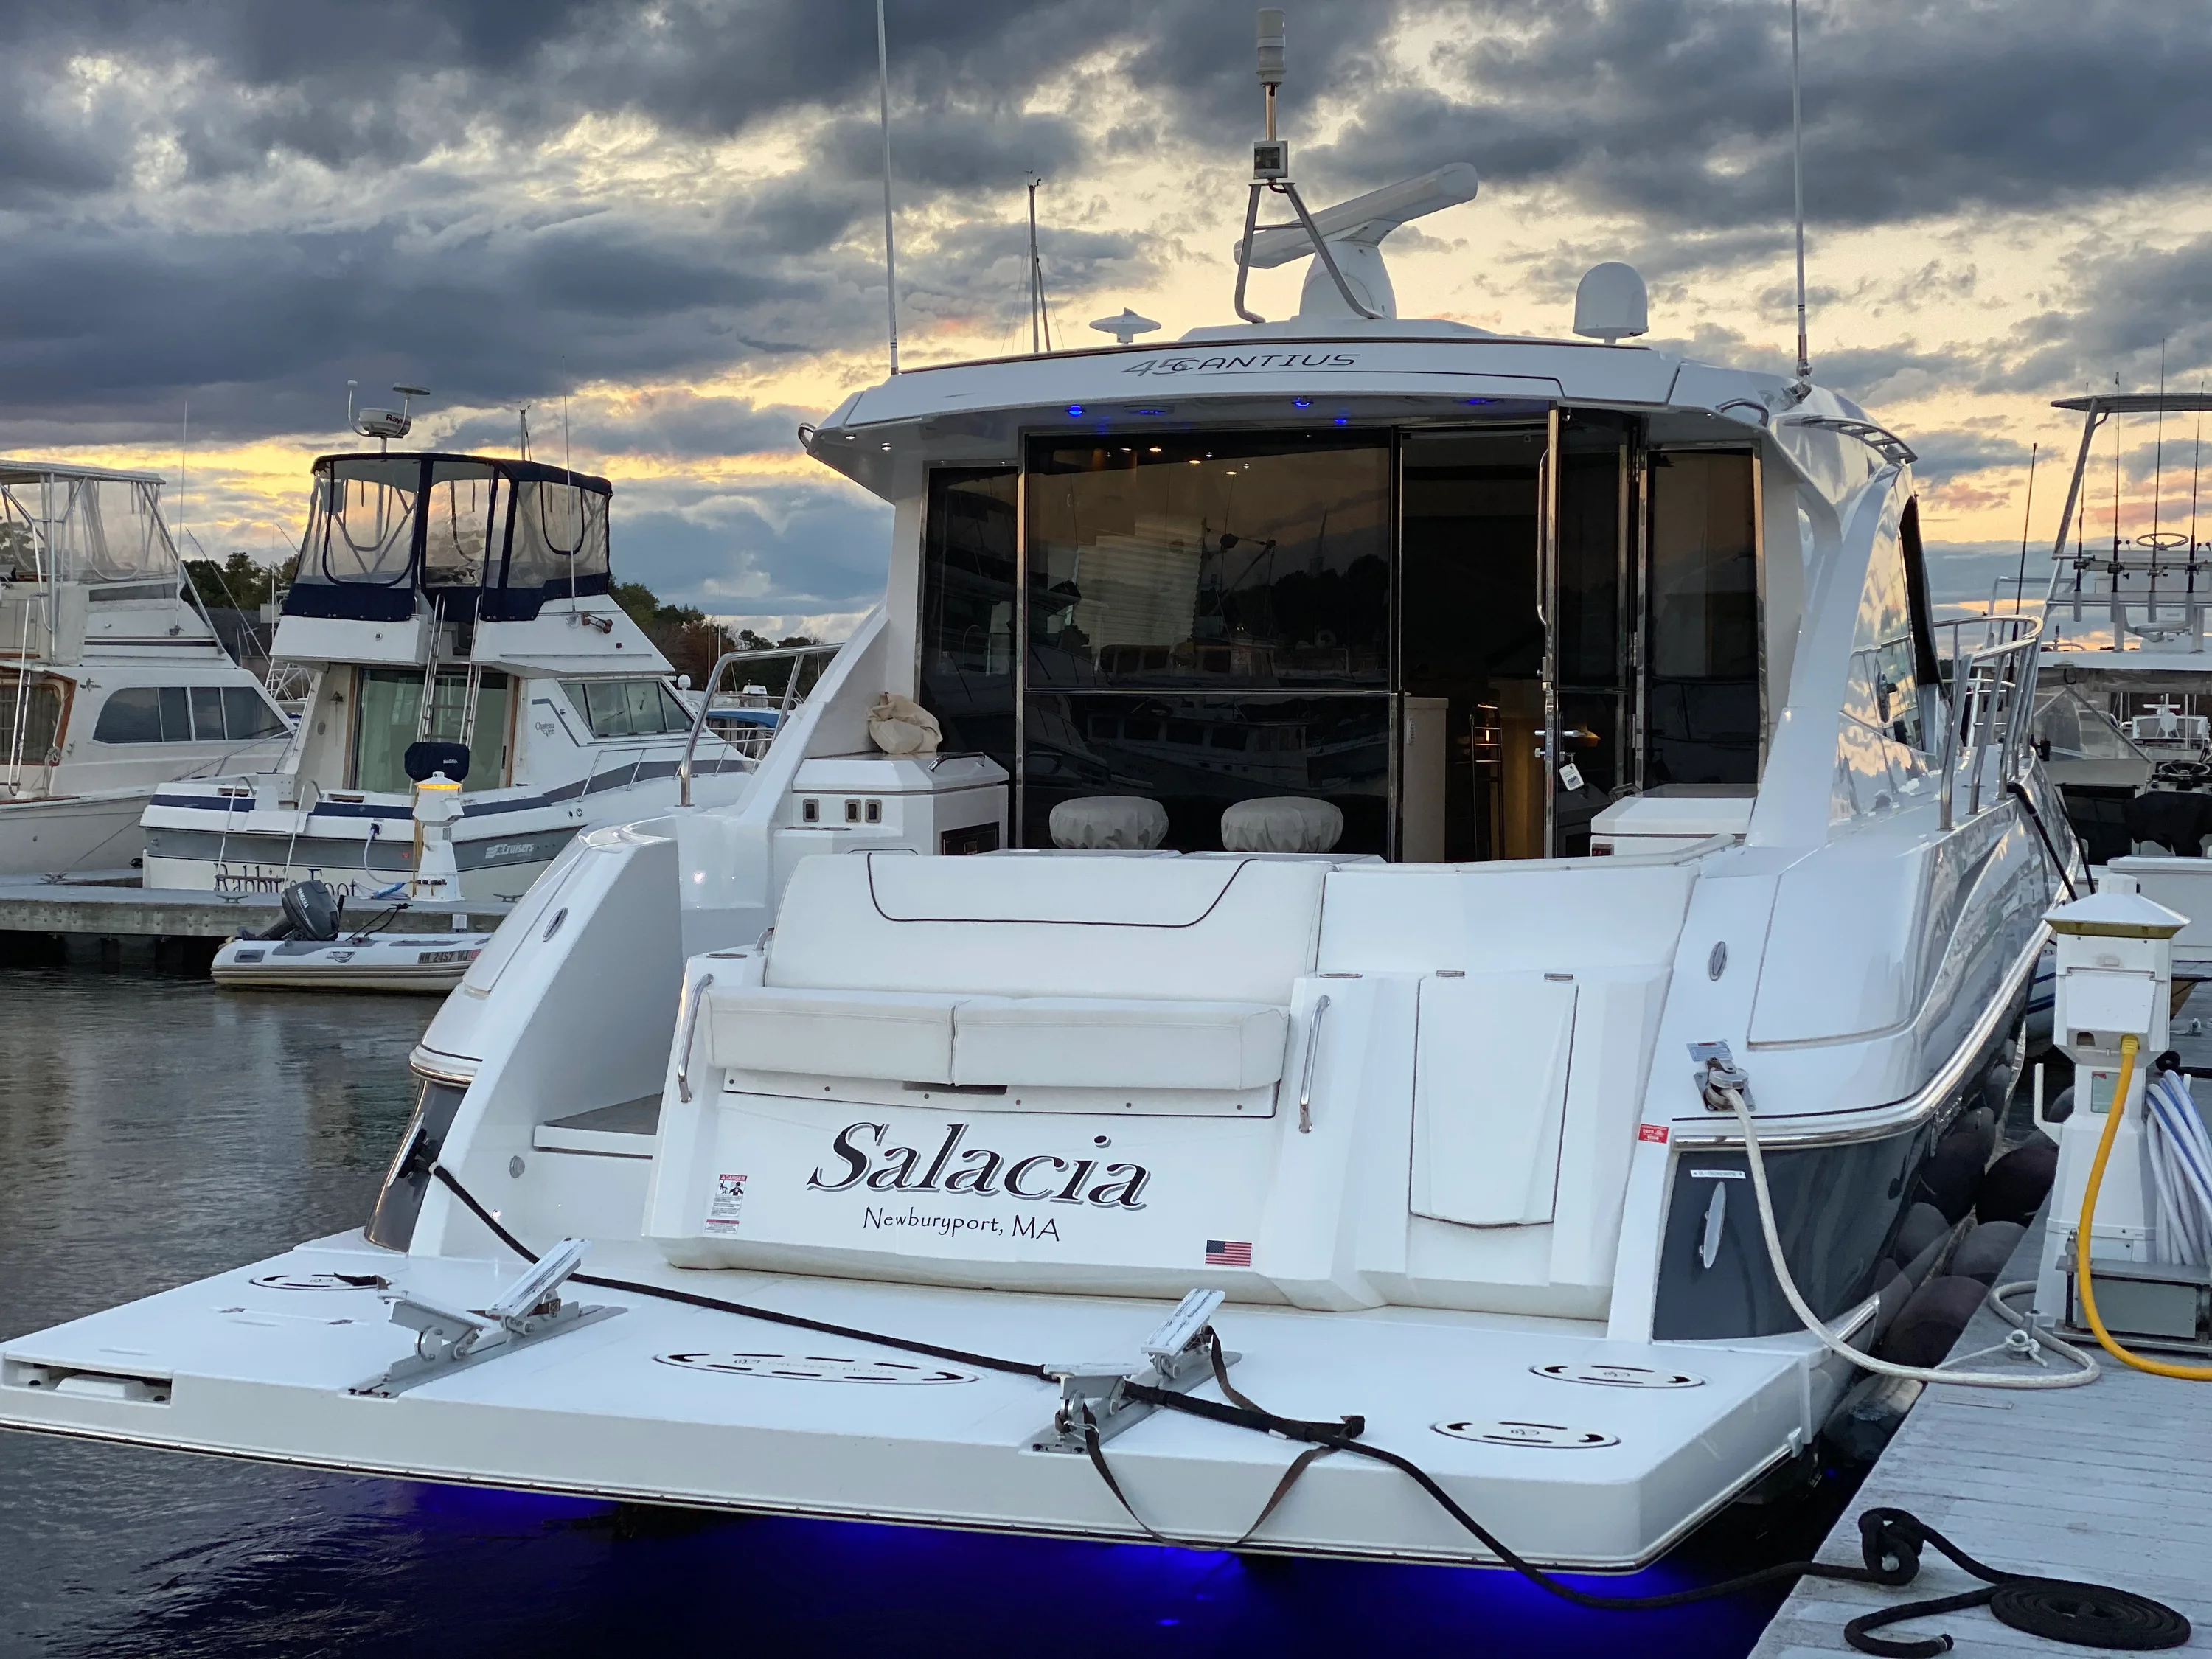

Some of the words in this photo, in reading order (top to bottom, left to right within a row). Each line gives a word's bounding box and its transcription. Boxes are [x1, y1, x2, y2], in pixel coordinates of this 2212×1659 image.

[1171, 353, 1361, 372] CANTIUS
[502, 843, 535, 855] Cruisers
[297, 887, 310, 908] YAMAHA
[807, 1121, 1151, 1211] Salacia
[863, 1206, 1004, 1237] Newburyport,
[1012, 1214, 1060, 1242] MA
